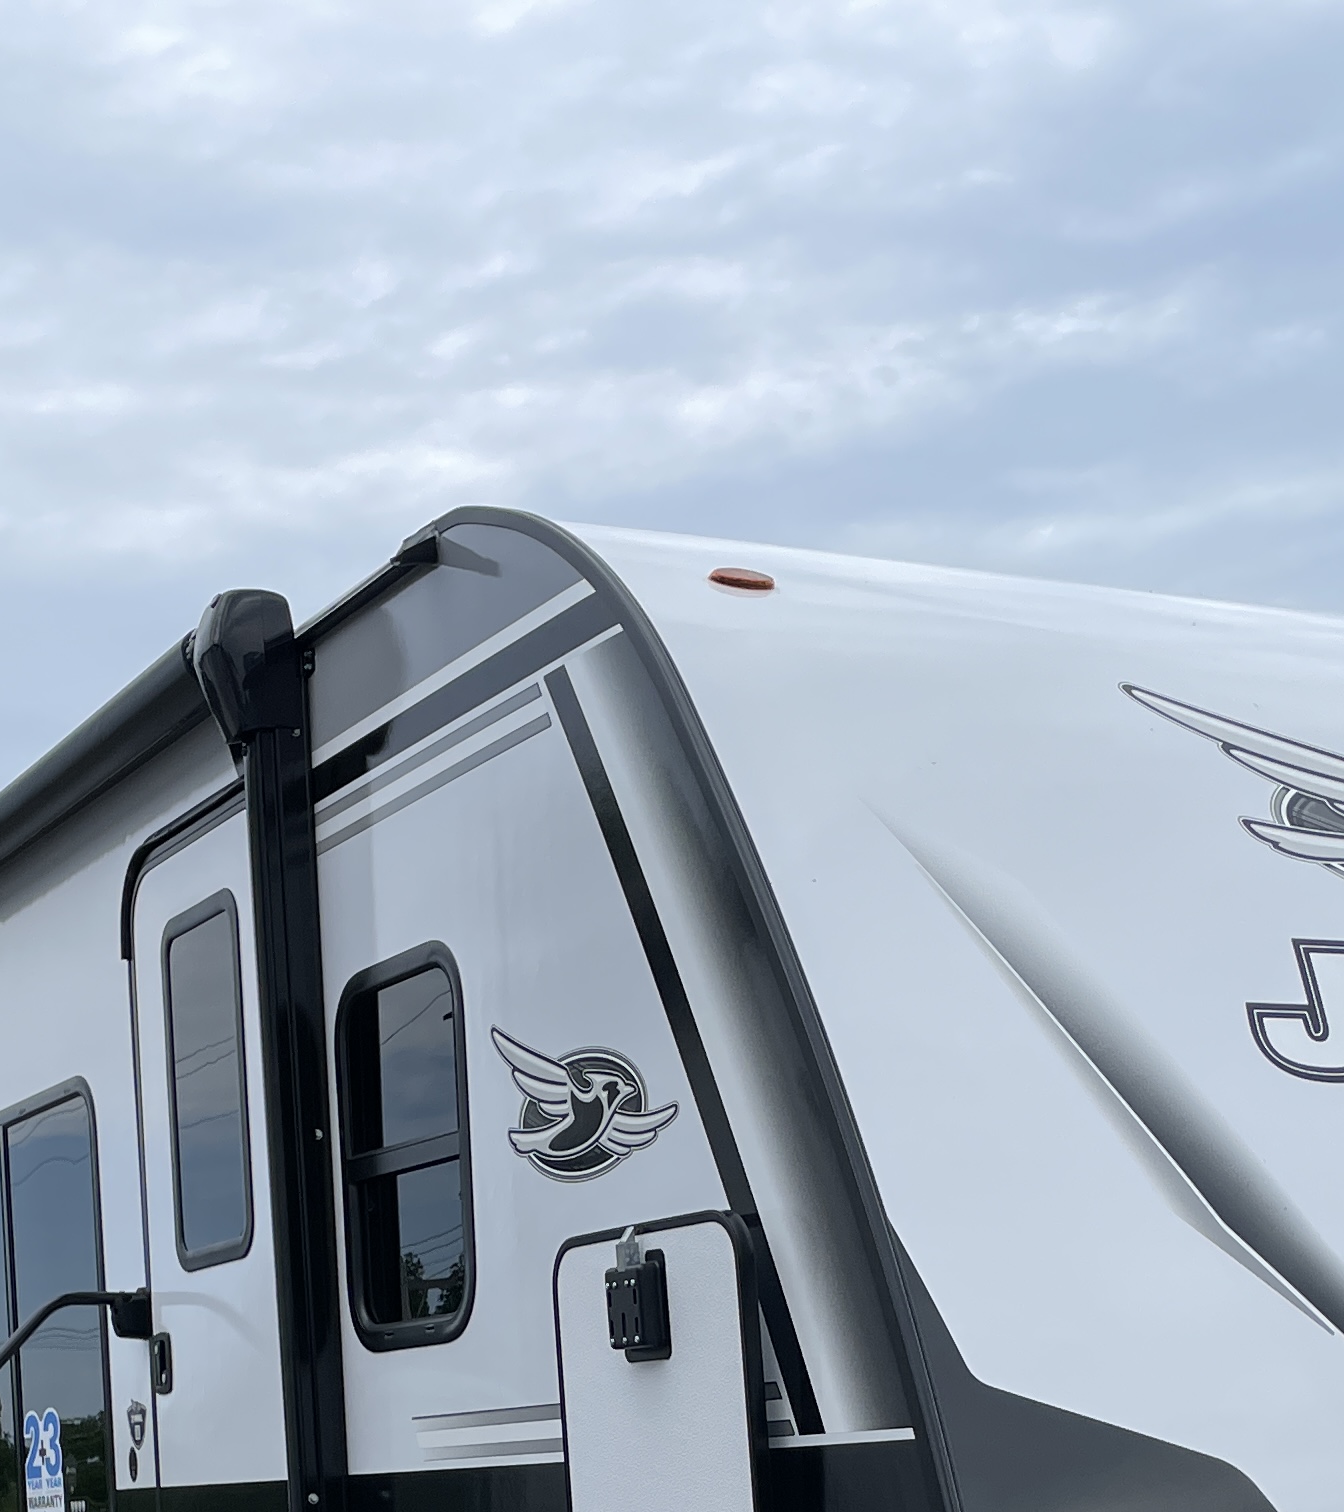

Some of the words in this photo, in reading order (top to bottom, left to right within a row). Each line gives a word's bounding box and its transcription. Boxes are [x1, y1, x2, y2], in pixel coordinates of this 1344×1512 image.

[28, 1479, 43, 1490] YEAR
[46, 1477, 62, 1488] YEAR
[28, 1494, 63, 1509] WARRANTY
